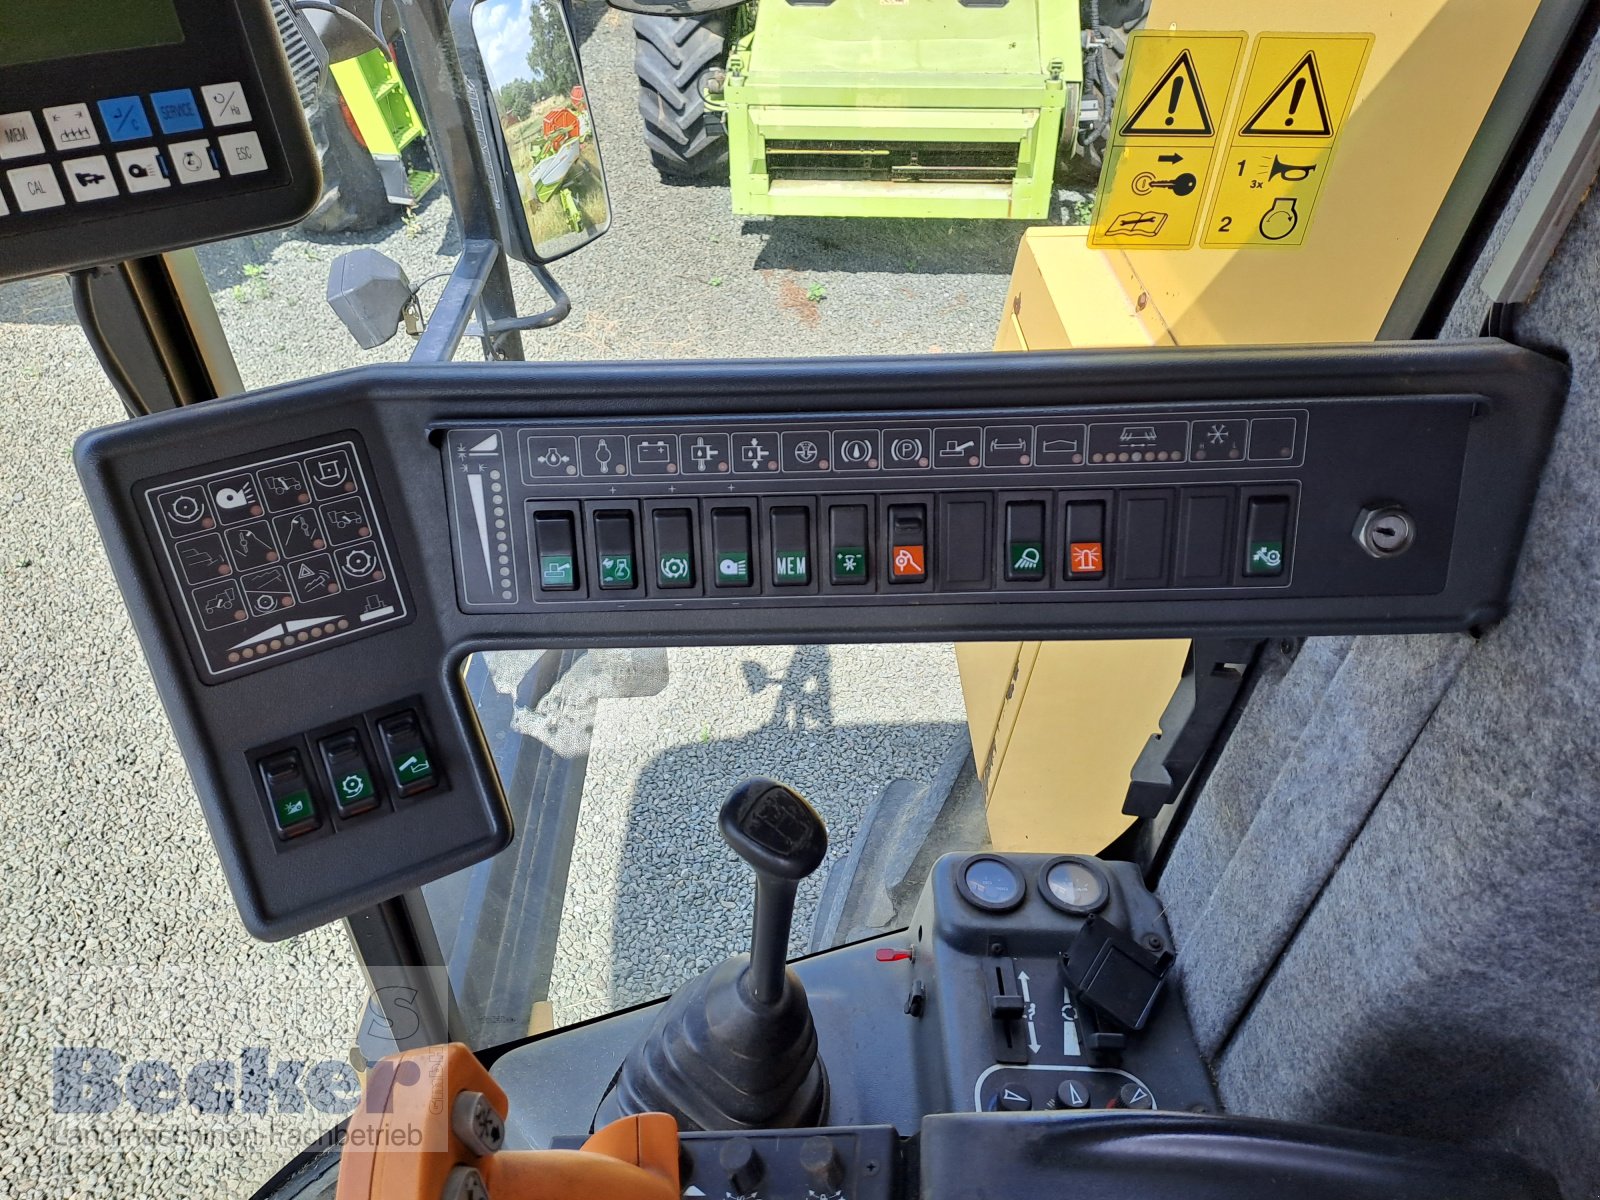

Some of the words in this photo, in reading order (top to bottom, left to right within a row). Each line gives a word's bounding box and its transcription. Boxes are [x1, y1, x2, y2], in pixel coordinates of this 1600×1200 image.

[160, 102, 195, 118] SERVICE
[5, 127, 28, 143] MEM
[235, 146, 253, 161] ESC
[1237, 160, 1246, 176] 1
[27, 180, 47, 195] CAL
[1250, 179, 1264, 189] 3x
[1218, 216, 1232, 232] 2
[777, 557, 806, 575] MEM
